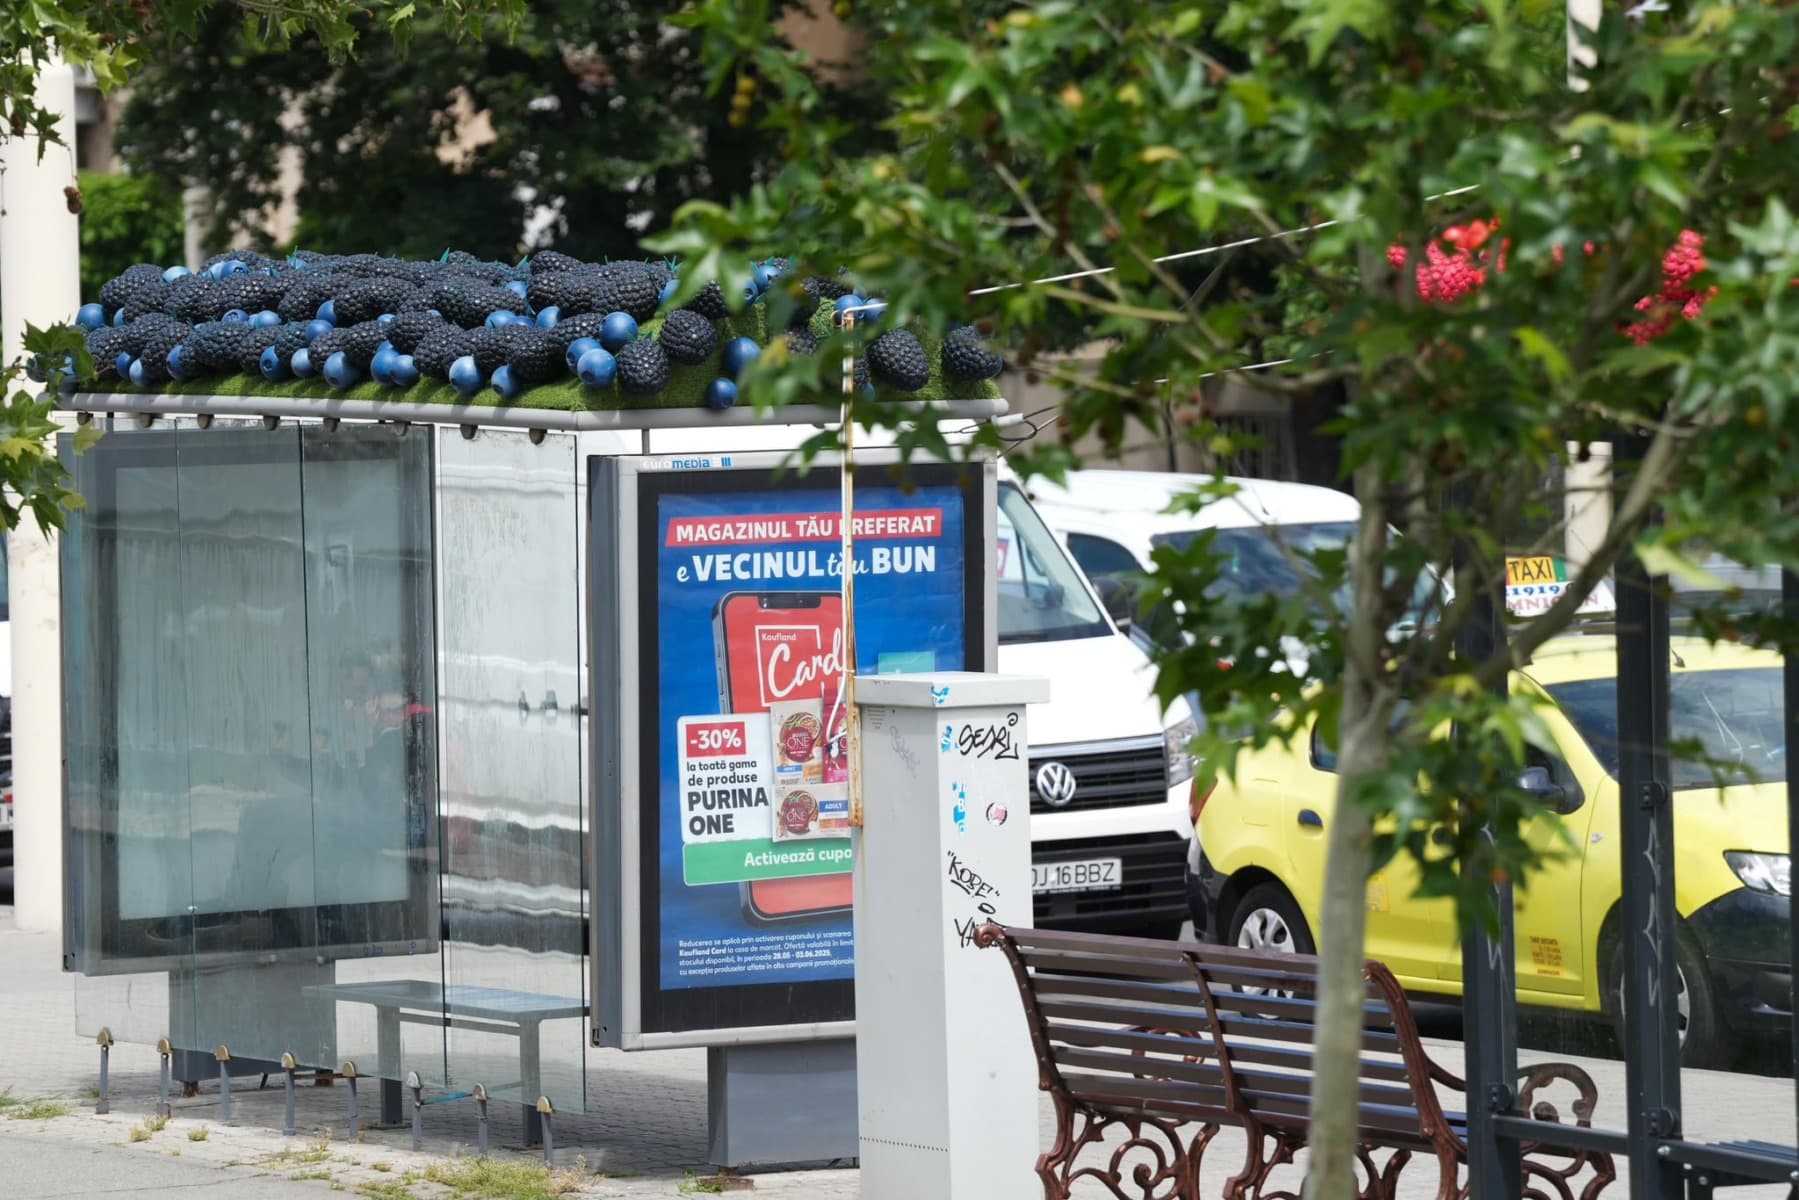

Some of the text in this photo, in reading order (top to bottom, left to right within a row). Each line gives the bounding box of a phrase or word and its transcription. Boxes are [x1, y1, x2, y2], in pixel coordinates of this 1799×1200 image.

[676, 515, 936, 542] MAGAZINUL TĂU REFERAT
[676, 565, 690, 583] e
[692, 550, 825, 581] VECINUL
[872, 546, 936, 575] BUN
[1508, 558, 1553, 581] TAXI
[1506, 585, 1560, 596] 1919
[761, 632, 797, 641] Kaufland
[768, 627, 843, 698] Card
[690, 728, 742, 750] -30%
[687, 760, 757, 772] la toată gama
[688, 772, 758, 788] de produse
[688, 787, 769, 811] PURINA
[689, 814, 735, 836] ONE
[744, 848, 852, 867] Activează cupo
[1055, 865, 1071, 885] 16
[1075, 862, 1115, 884] BBZ
[679, 947, 710, 957] Kaufland
[711, 946, 727, 955] Card
